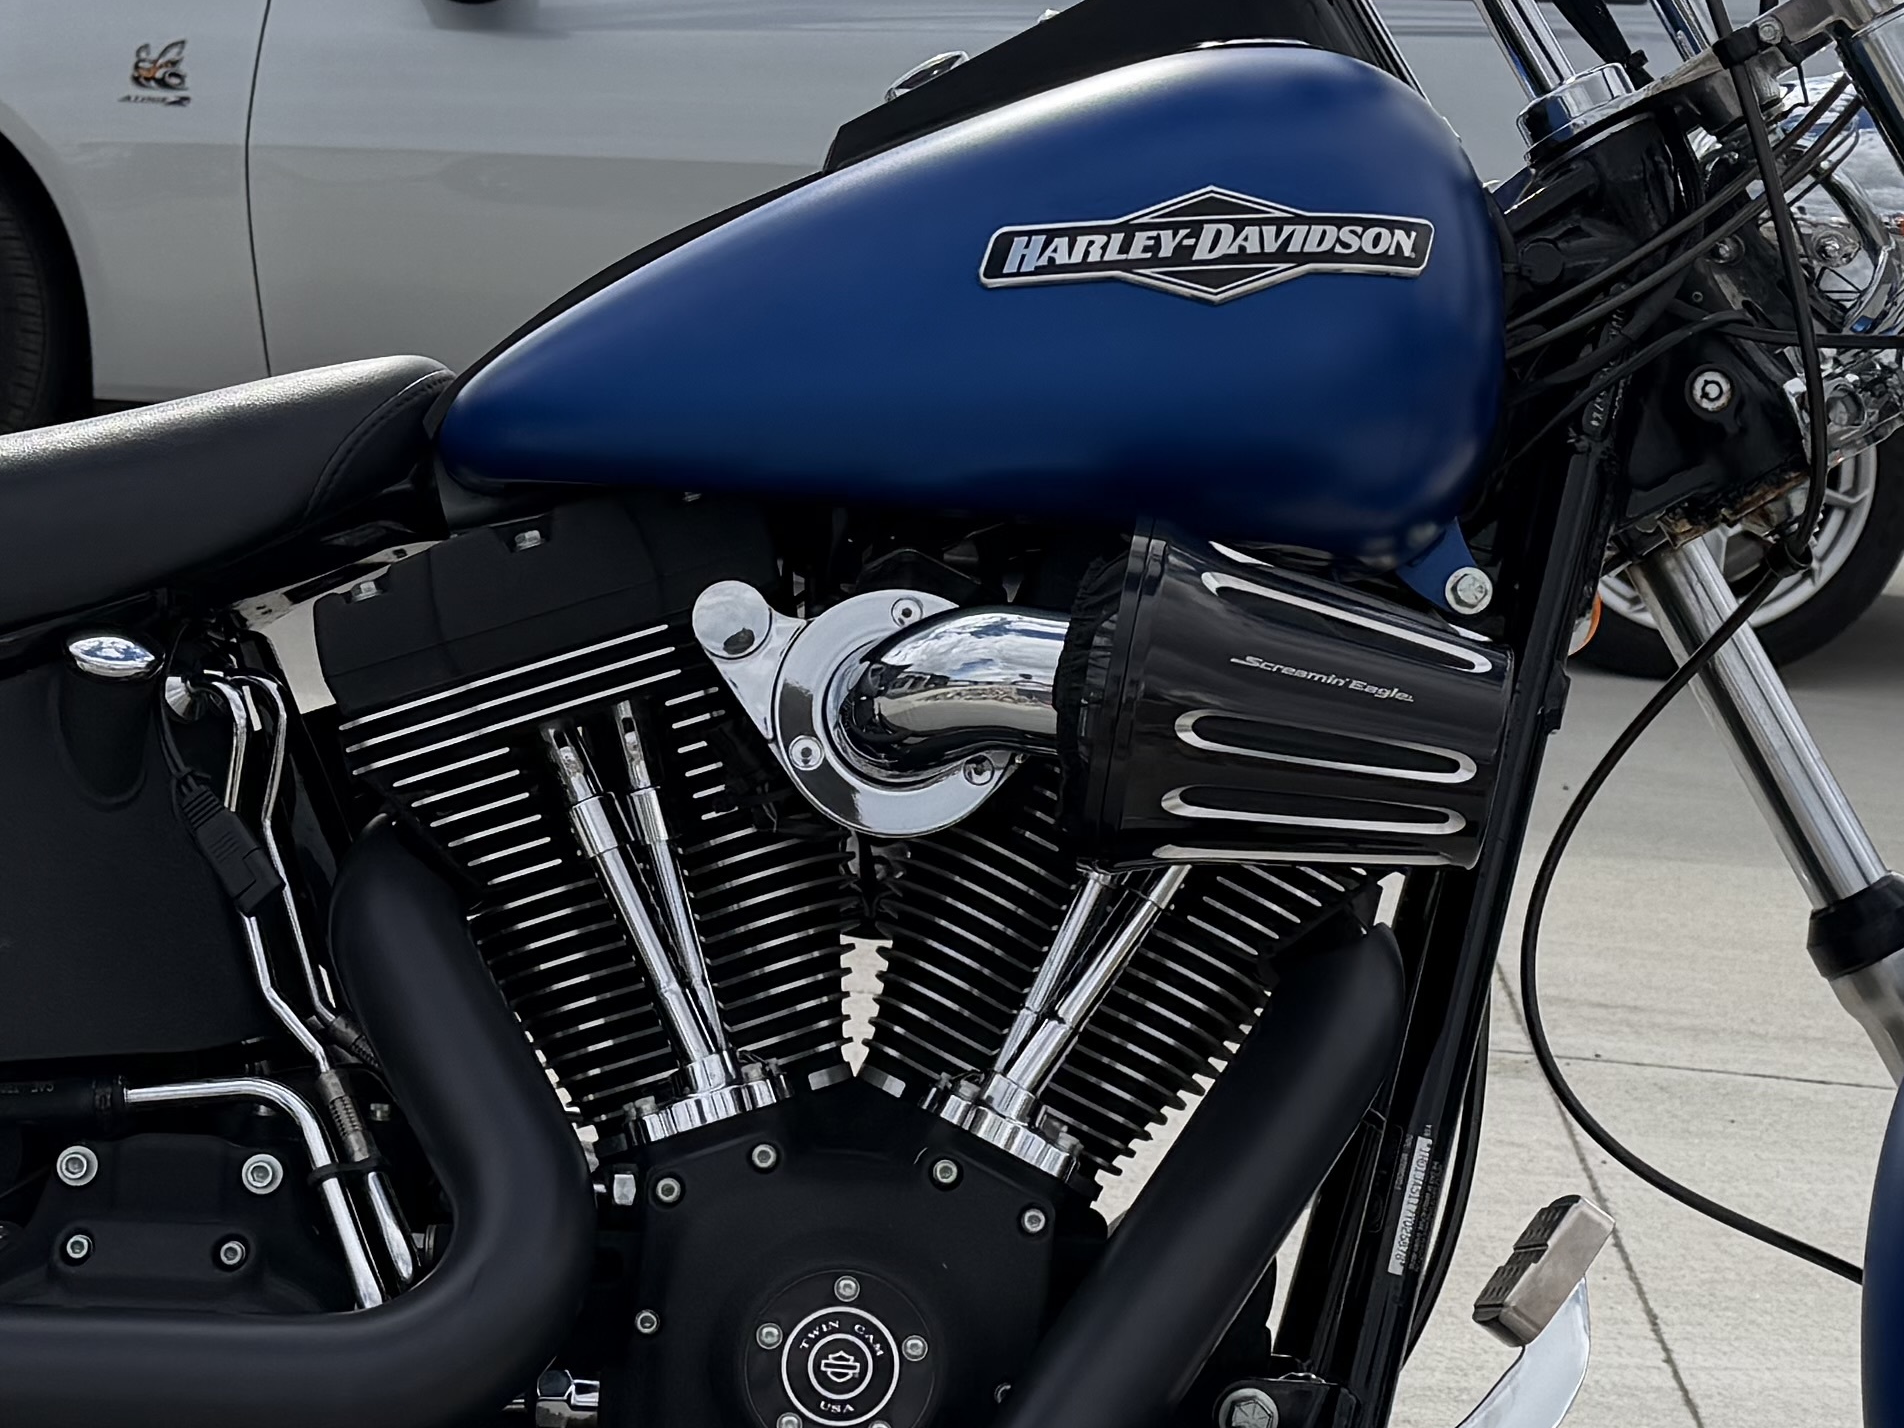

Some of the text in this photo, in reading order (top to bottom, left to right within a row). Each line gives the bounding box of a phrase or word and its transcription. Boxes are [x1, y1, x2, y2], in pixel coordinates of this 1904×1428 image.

[1002, 222, 1415, 273] HARLEY-DAVIDSON
[1348, 680, 1410, 700] Eagle
[799, 1320, 884, 1357] TWIN CAM
[819, 1400, 855, 1413] USA
